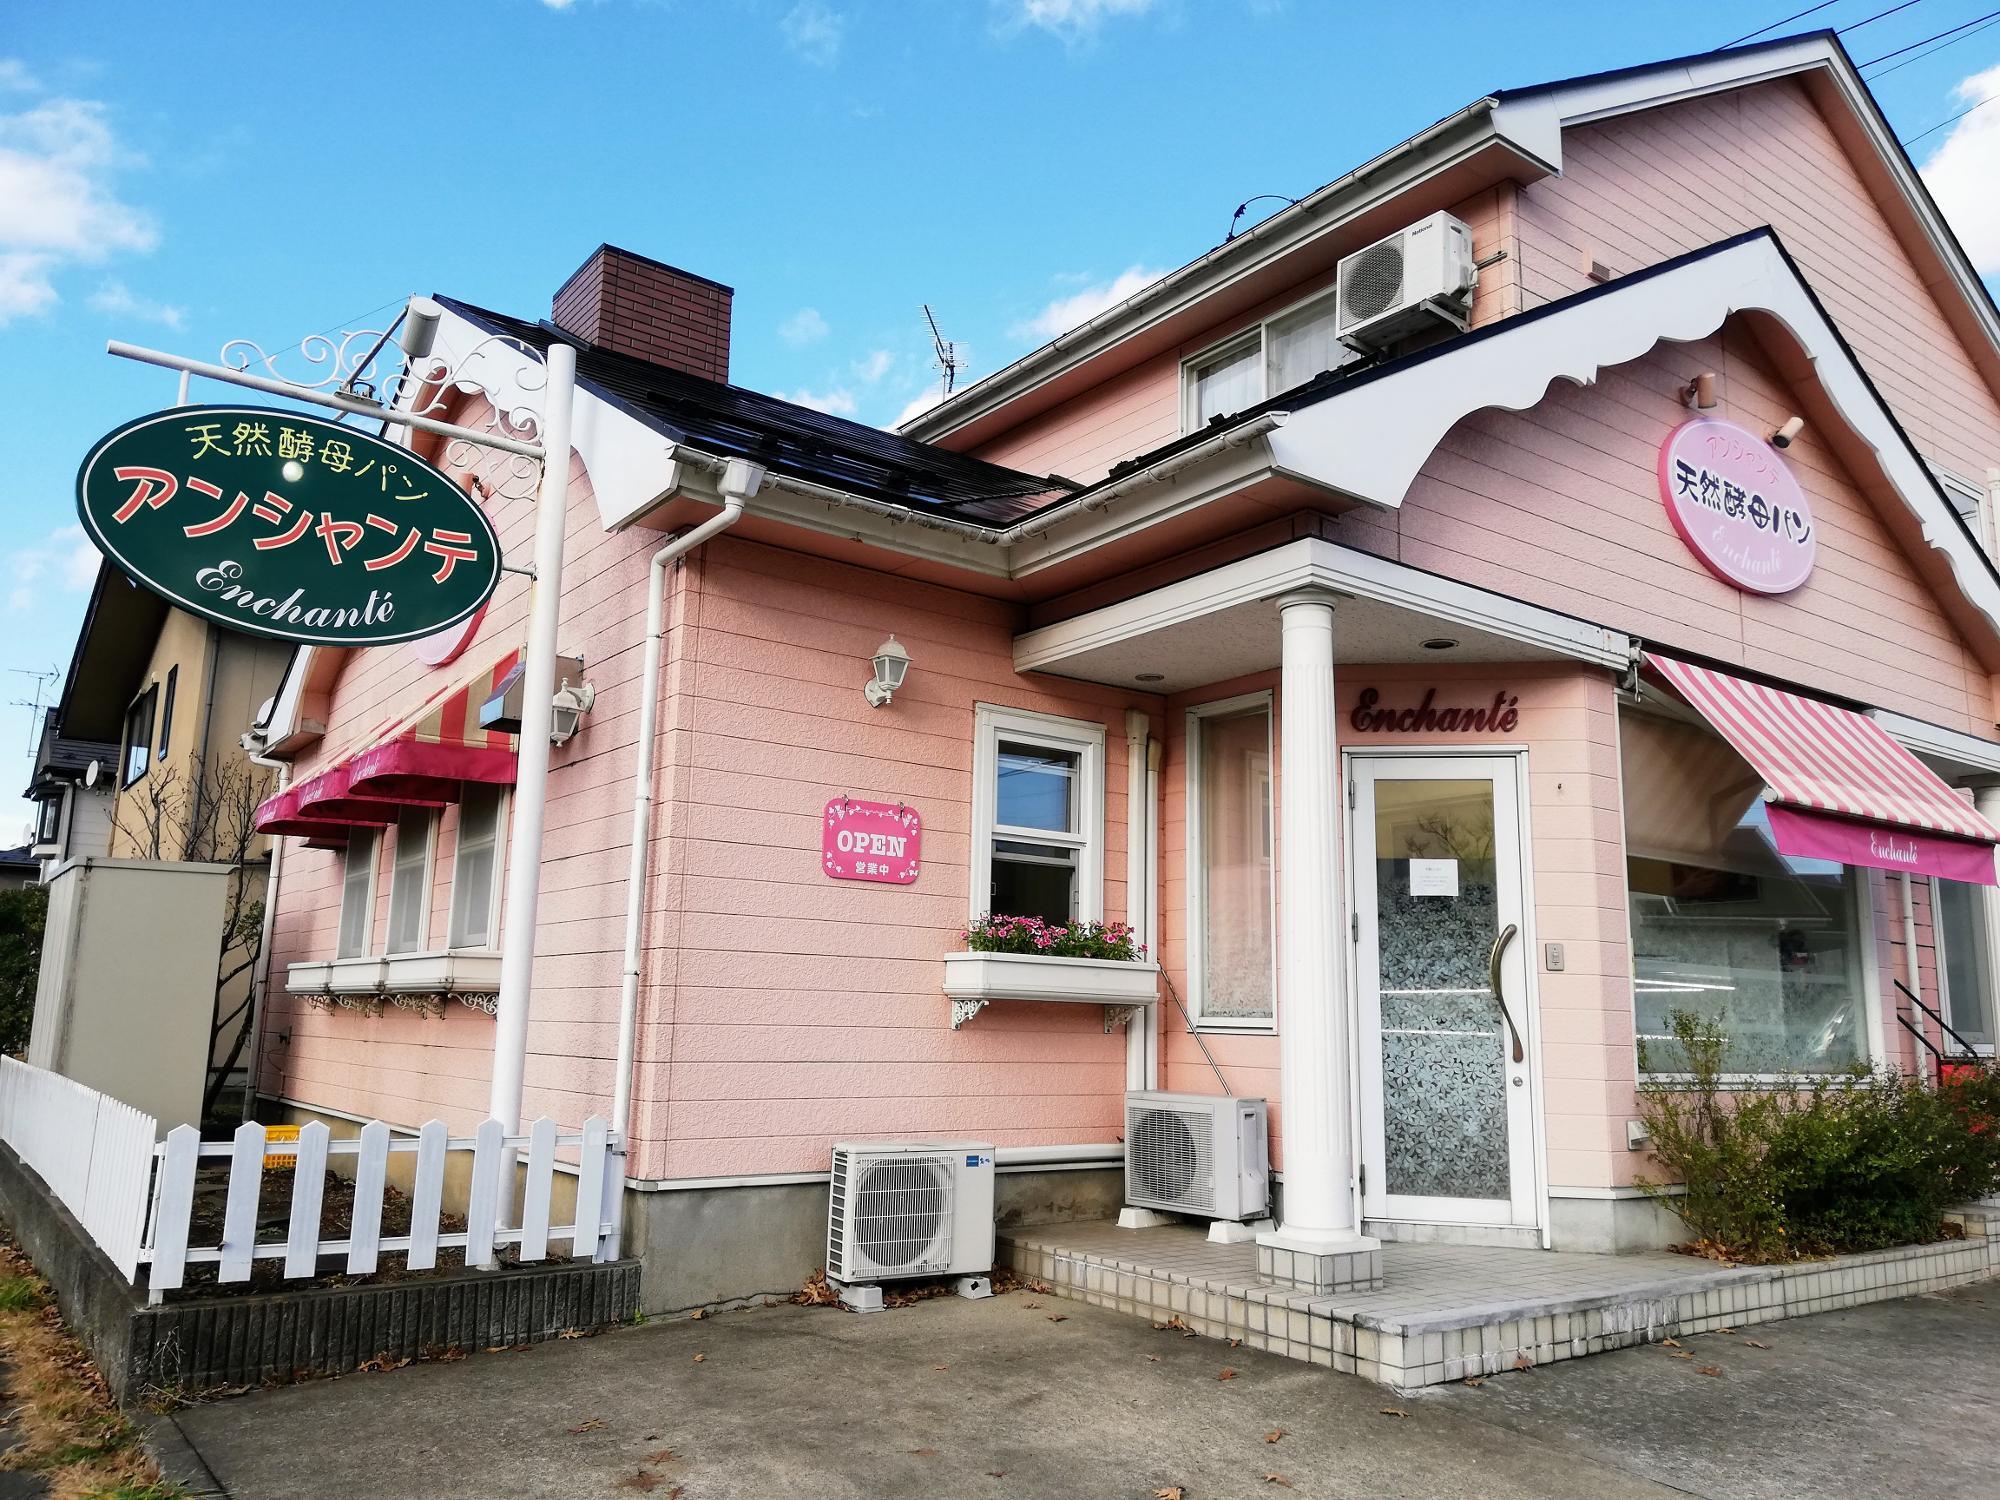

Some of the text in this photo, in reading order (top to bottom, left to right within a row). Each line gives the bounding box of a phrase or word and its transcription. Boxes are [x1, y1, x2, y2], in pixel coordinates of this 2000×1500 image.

[185, 422, 429, 501] 天然酵母パン
[1676, 459, 1811, 544] 天然酵母パン
[195, 560, 395, 629] Enchanté
[1350, 687, 1519, 733] Enchanté
[837, 830, 907, 858] OPEN
[1870, 831, 1919, 865] Enchanté
[855, 860, 890, 877] 営業中
